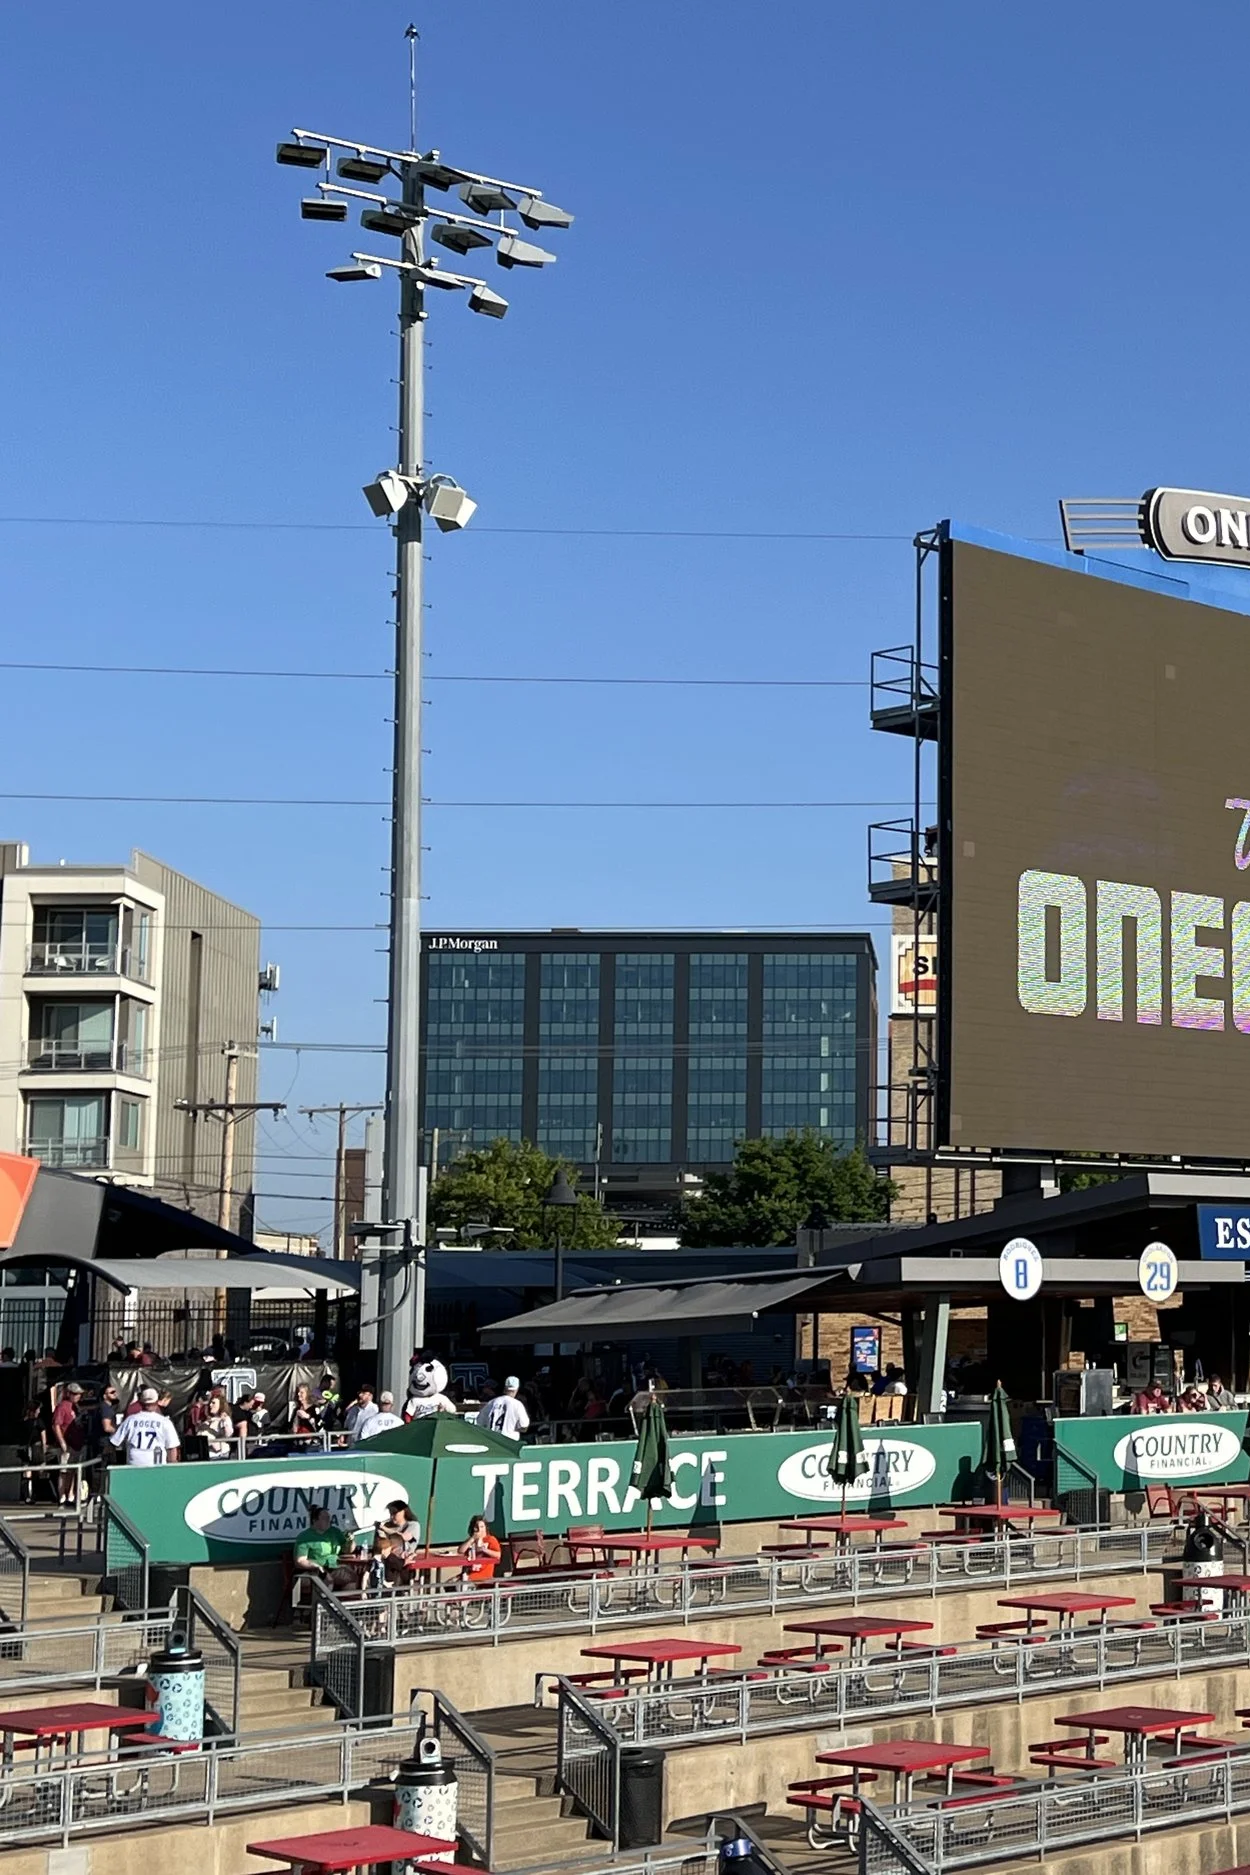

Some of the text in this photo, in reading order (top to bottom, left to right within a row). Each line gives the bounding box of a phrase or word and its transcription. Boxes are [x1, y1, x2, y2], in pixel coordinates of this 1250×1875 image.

[1014, 1258, 1029, 1290] 8
[1146, 1261, 1171, 1291] 29
[136, 1431, 157, 1449] 17
[1132, 1432, 1224, 1458] COUNTRY
[217, 1482, 380, 1518] COUNTRY
